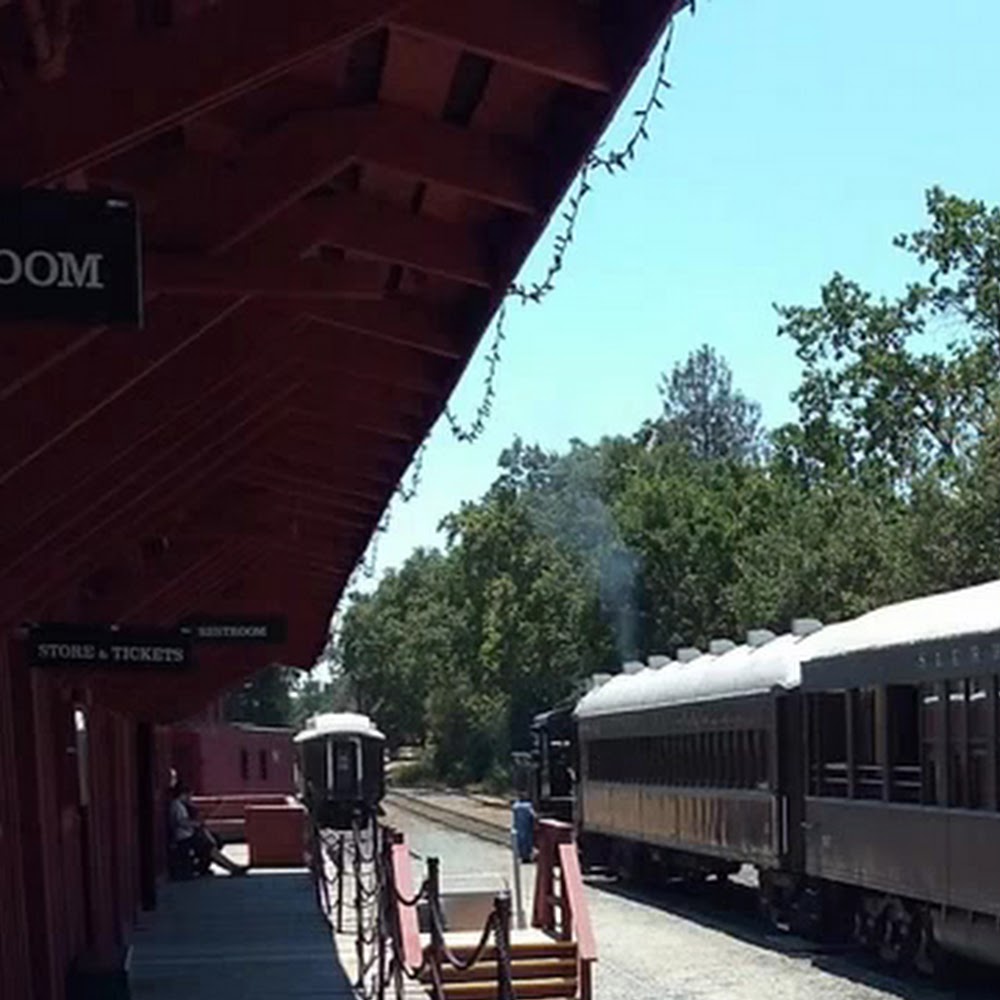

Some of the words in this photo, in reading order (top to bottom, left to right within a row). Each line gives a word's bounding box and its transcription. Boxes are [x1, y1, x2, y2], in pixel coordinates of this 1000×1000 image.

[198, 626, 268, 638] RESTROOM
[37, 643, 96, 660] STORE
[99, 650, 109, 660] &
[111, 646, 185, 663] TICKETS
